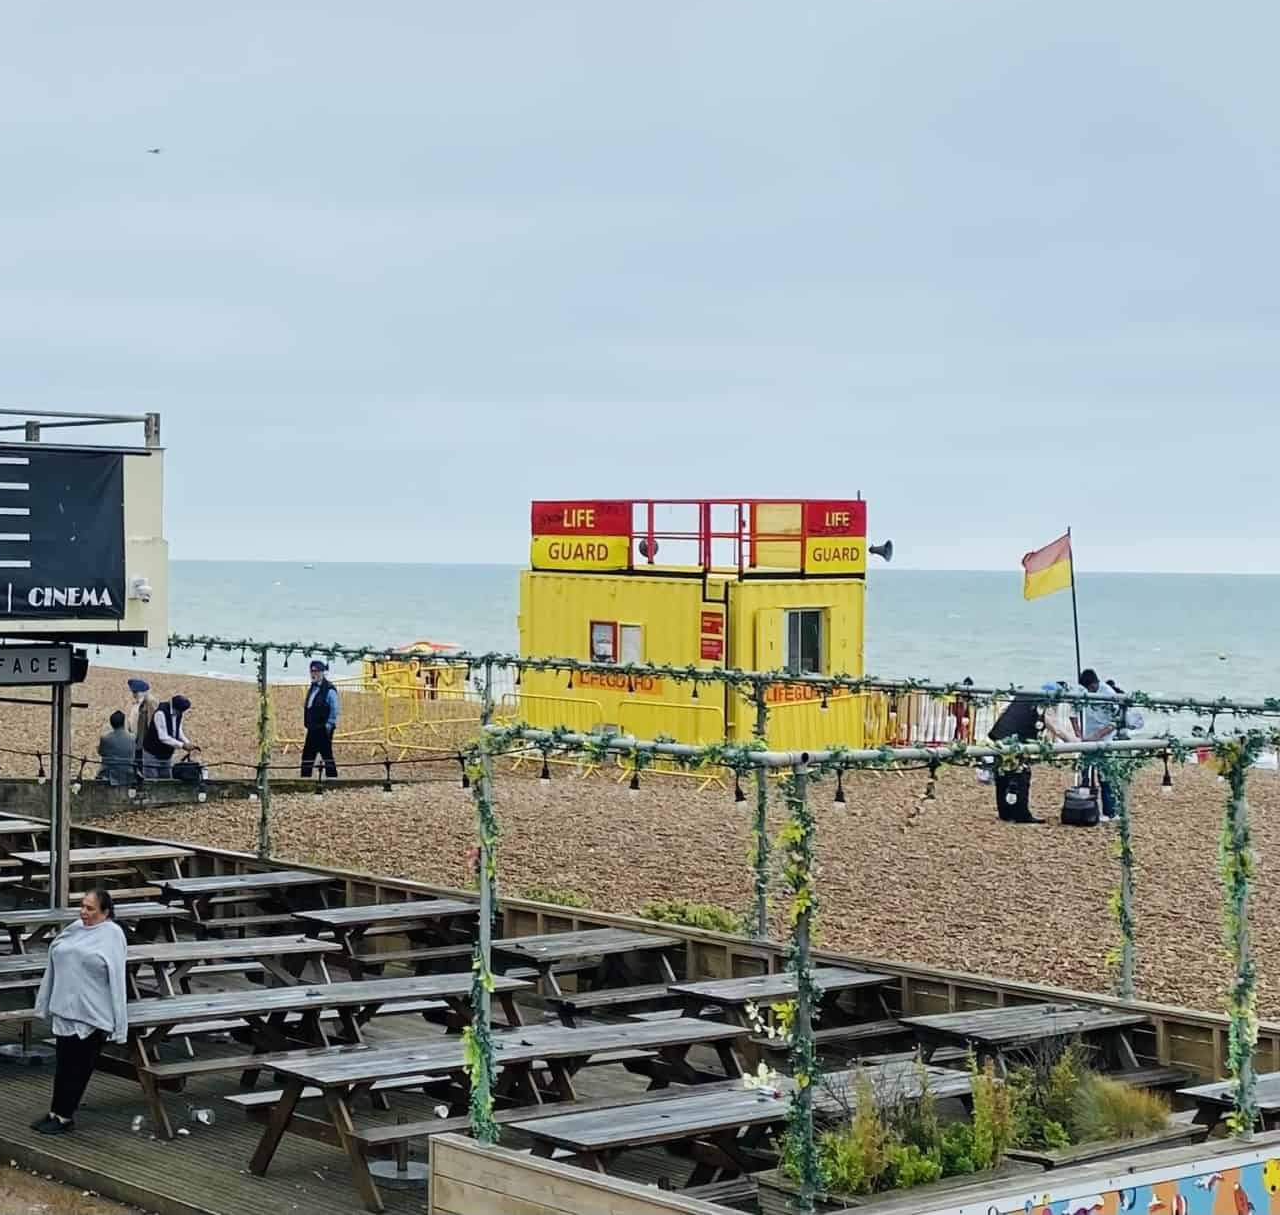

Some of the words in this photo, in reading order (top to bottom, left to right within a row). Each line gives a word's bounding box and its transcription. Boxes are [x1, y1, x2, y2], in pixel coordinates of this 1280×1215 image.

[563, 508, 596, 529] LIFE
[825, 511, 850, 527] LIFE
[549, 541, 609, 563] GUARD
[812, 547, 860, 563] GUARD
[28, 587, 112, 608] CINEMA
[580, 671, 654, 691] LIFEGURD
